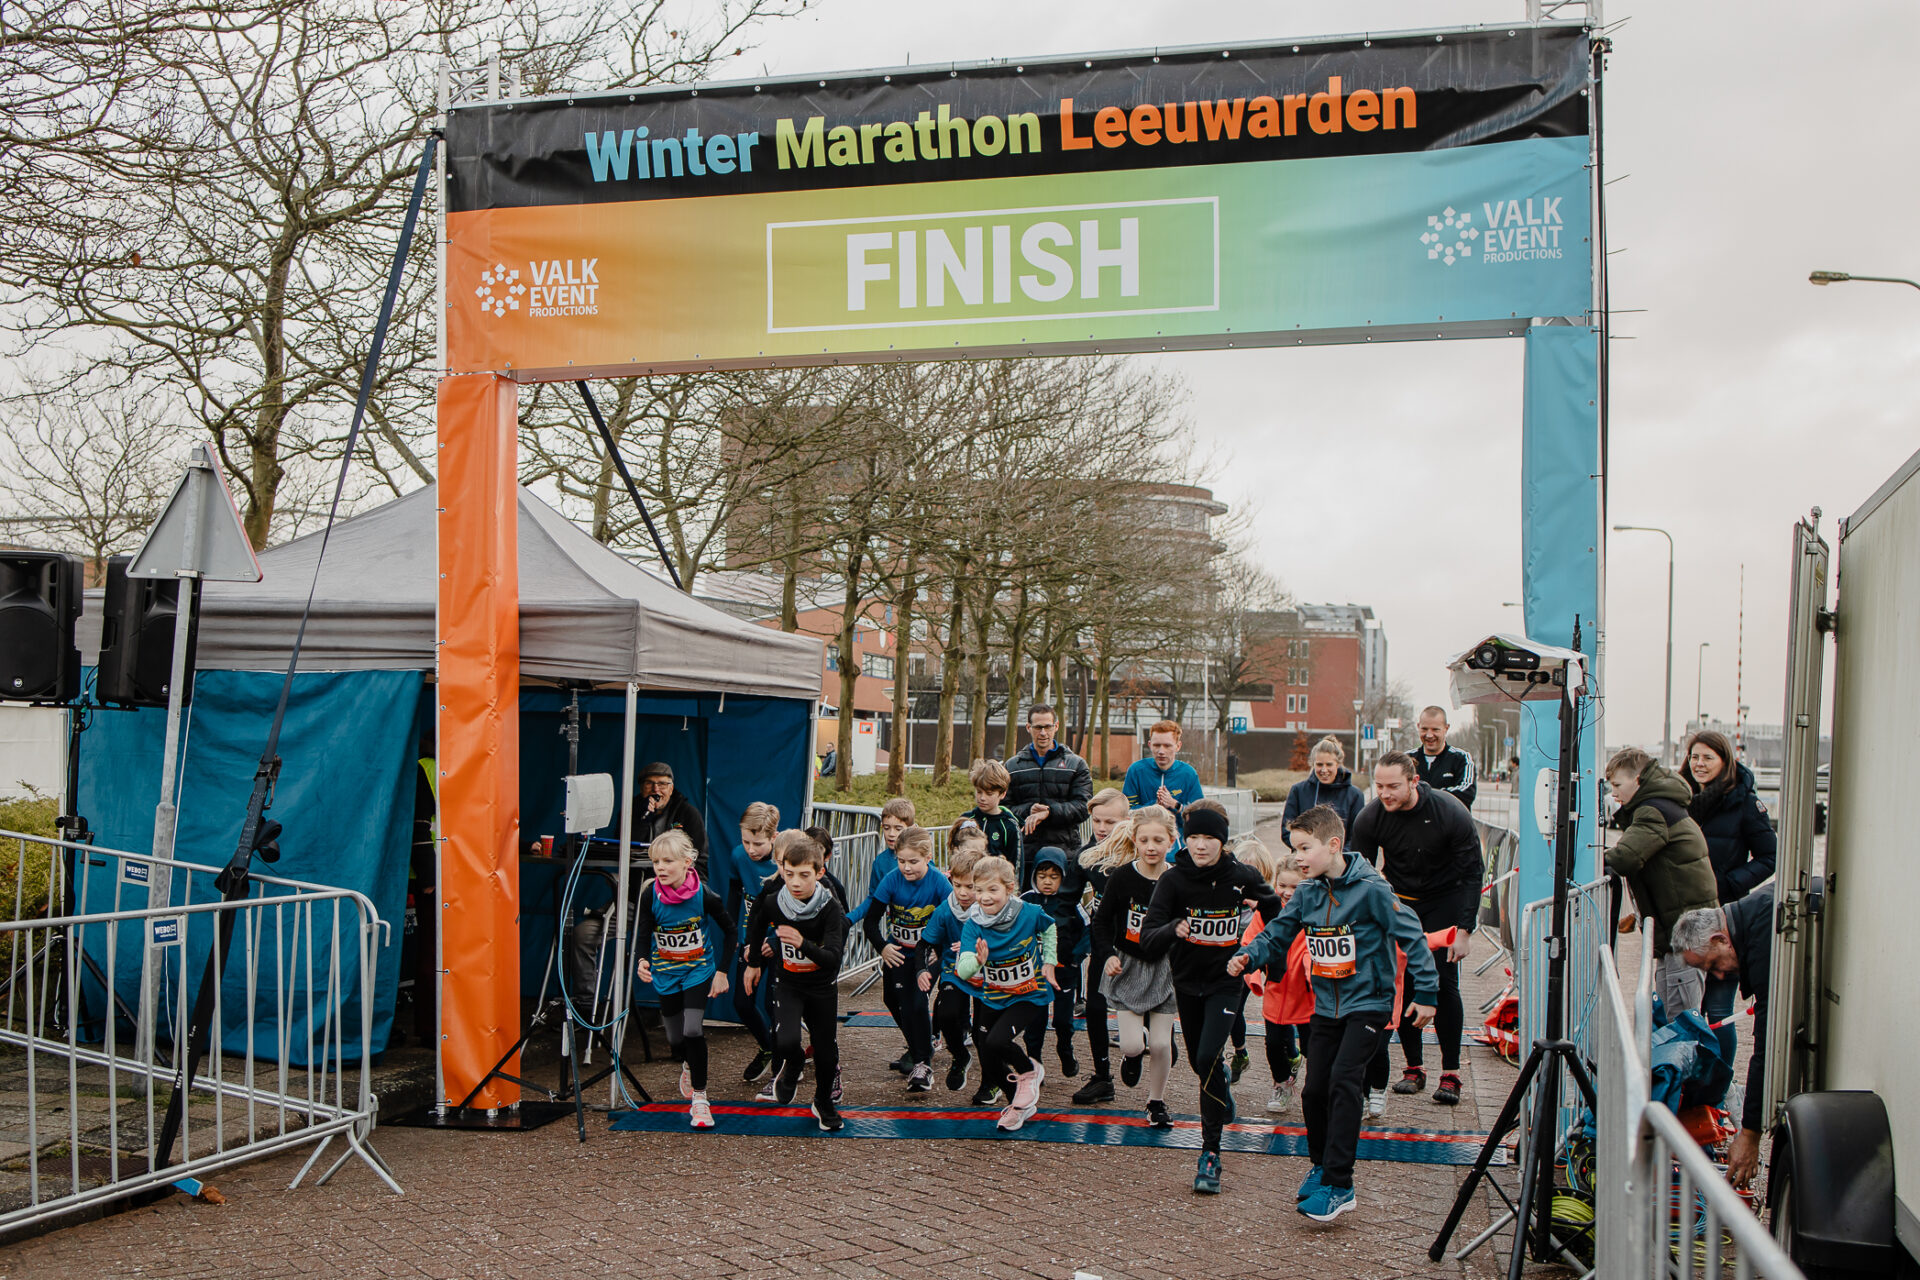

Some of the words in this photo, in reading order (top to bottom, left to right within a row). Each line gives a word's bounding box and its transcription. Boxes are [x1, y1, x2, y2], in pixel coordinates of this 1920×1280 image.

[585, 126, 759, 182] Winter
[776, 104, 1041, 170] Marathon
[1060, 76, 1416, 150] Leeuwarden
[1483, 197, 1563, 228] VALK
[1484, 225, 1563, 252] EVENT
[847, 217, 1139, 311] FINISH
[1483, 248, 1563, 264] PRODUCTIONS
[529, 258, 599, 286] VALK
[530, 285, 599, 307] EVENT
[529, 305, 599, 317] PRODUCTIONS
[893, 924, 922, 941] 501
[1190, 919, 1237, 936] 5000
[657, 932, 699, 947] 5024
[1308, 937, 1351, 957] 5006
[987, 962, 1031, 982] 5015
